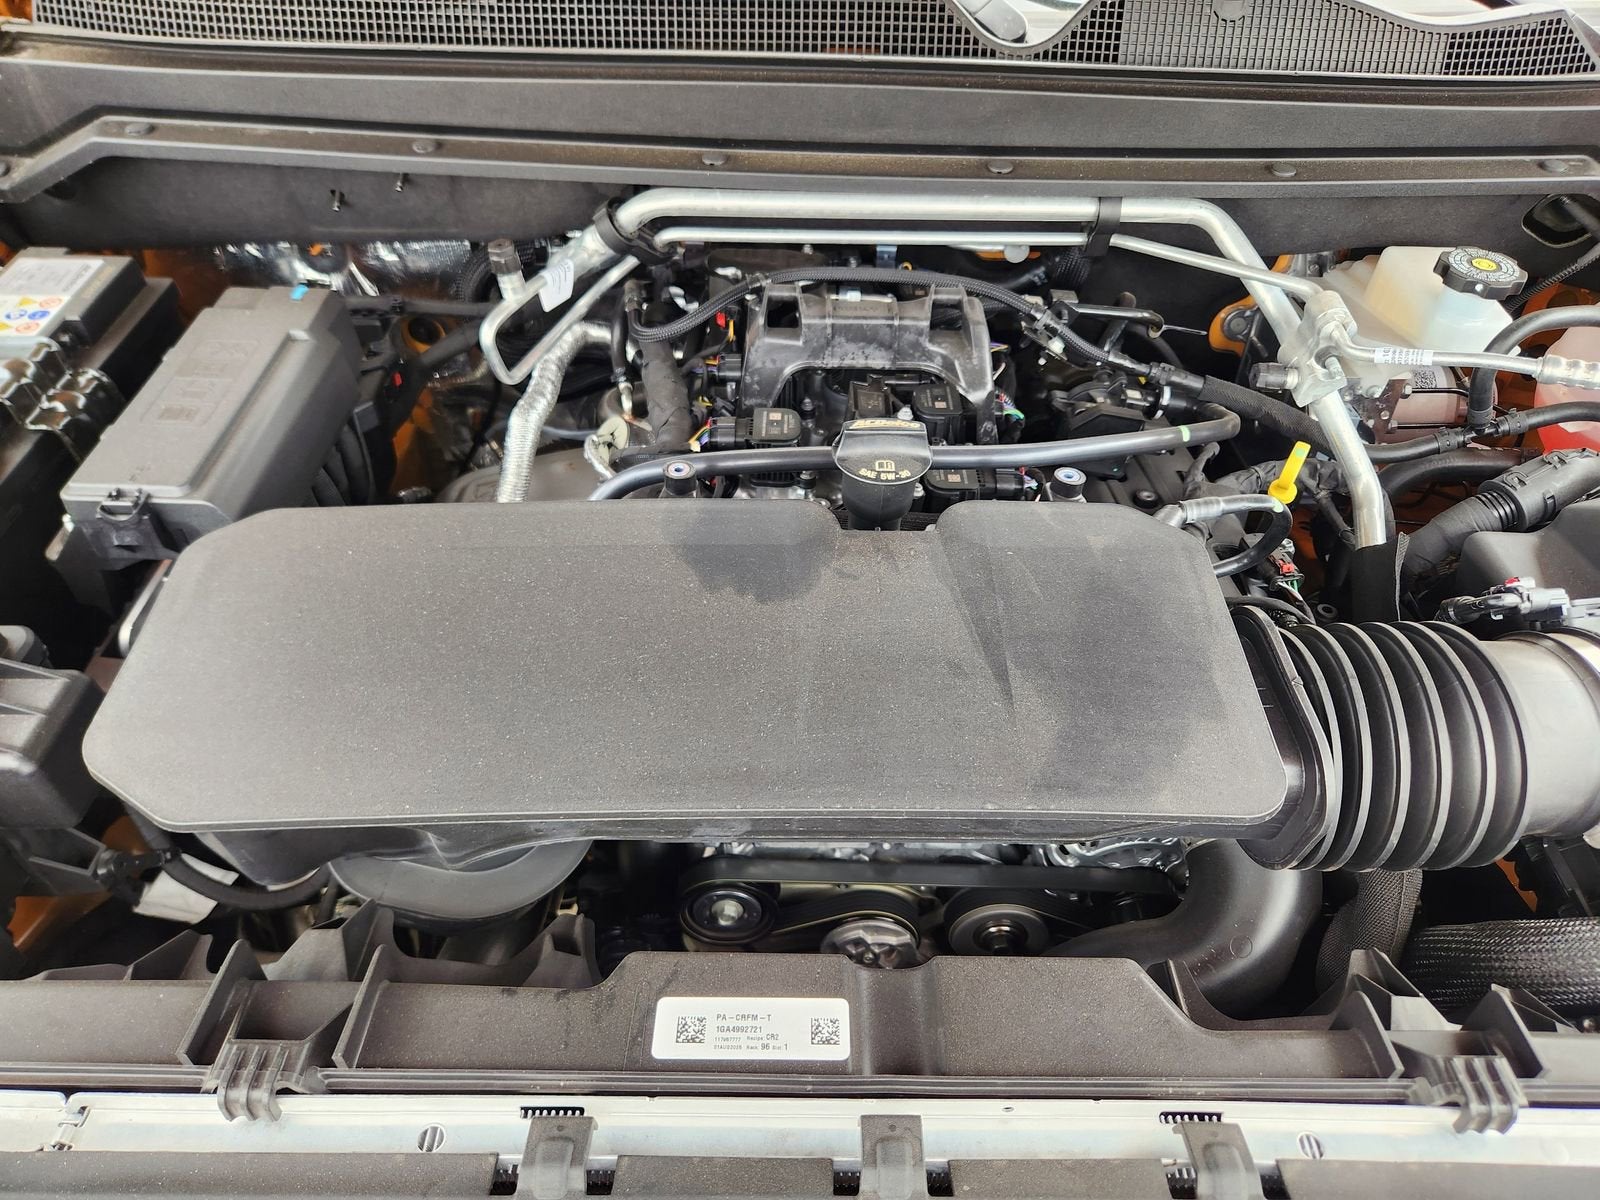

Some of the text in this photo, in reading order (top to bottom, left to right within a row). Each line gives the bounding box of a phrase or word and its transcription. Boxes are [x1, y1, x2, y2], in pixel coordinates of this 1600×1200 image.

[859, 468, 911, 480] SAE 5W-30
[716, 1025, 762, 1033] 1GA4992721
[766, 1033, 779, 1041] CR2
